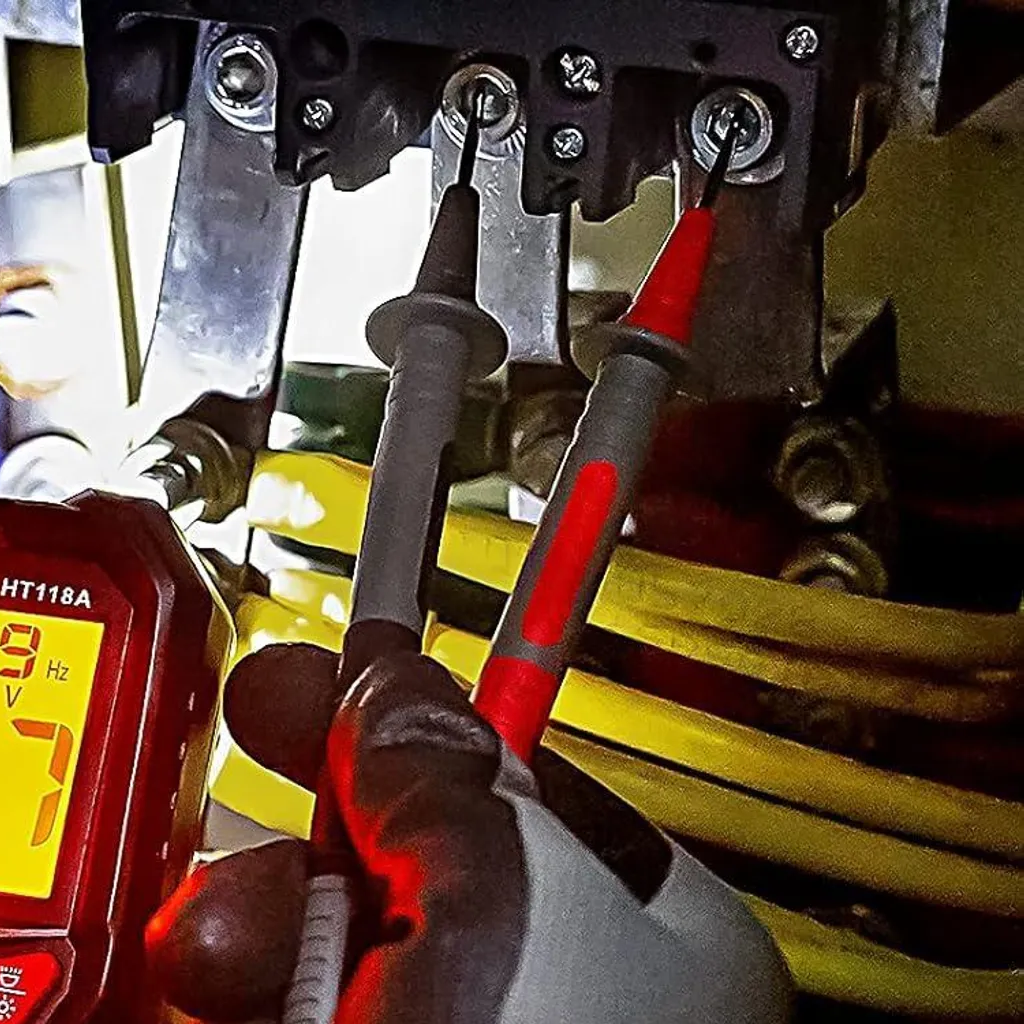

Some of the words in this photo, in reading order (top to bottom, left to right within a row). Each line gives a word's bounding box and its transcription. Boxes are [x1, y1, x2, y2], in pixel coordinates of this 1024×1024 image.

[0, 577, 92, 609] HT118A
[46, 660, 70, 683] Hz
[6, 685, 23, 709] V
